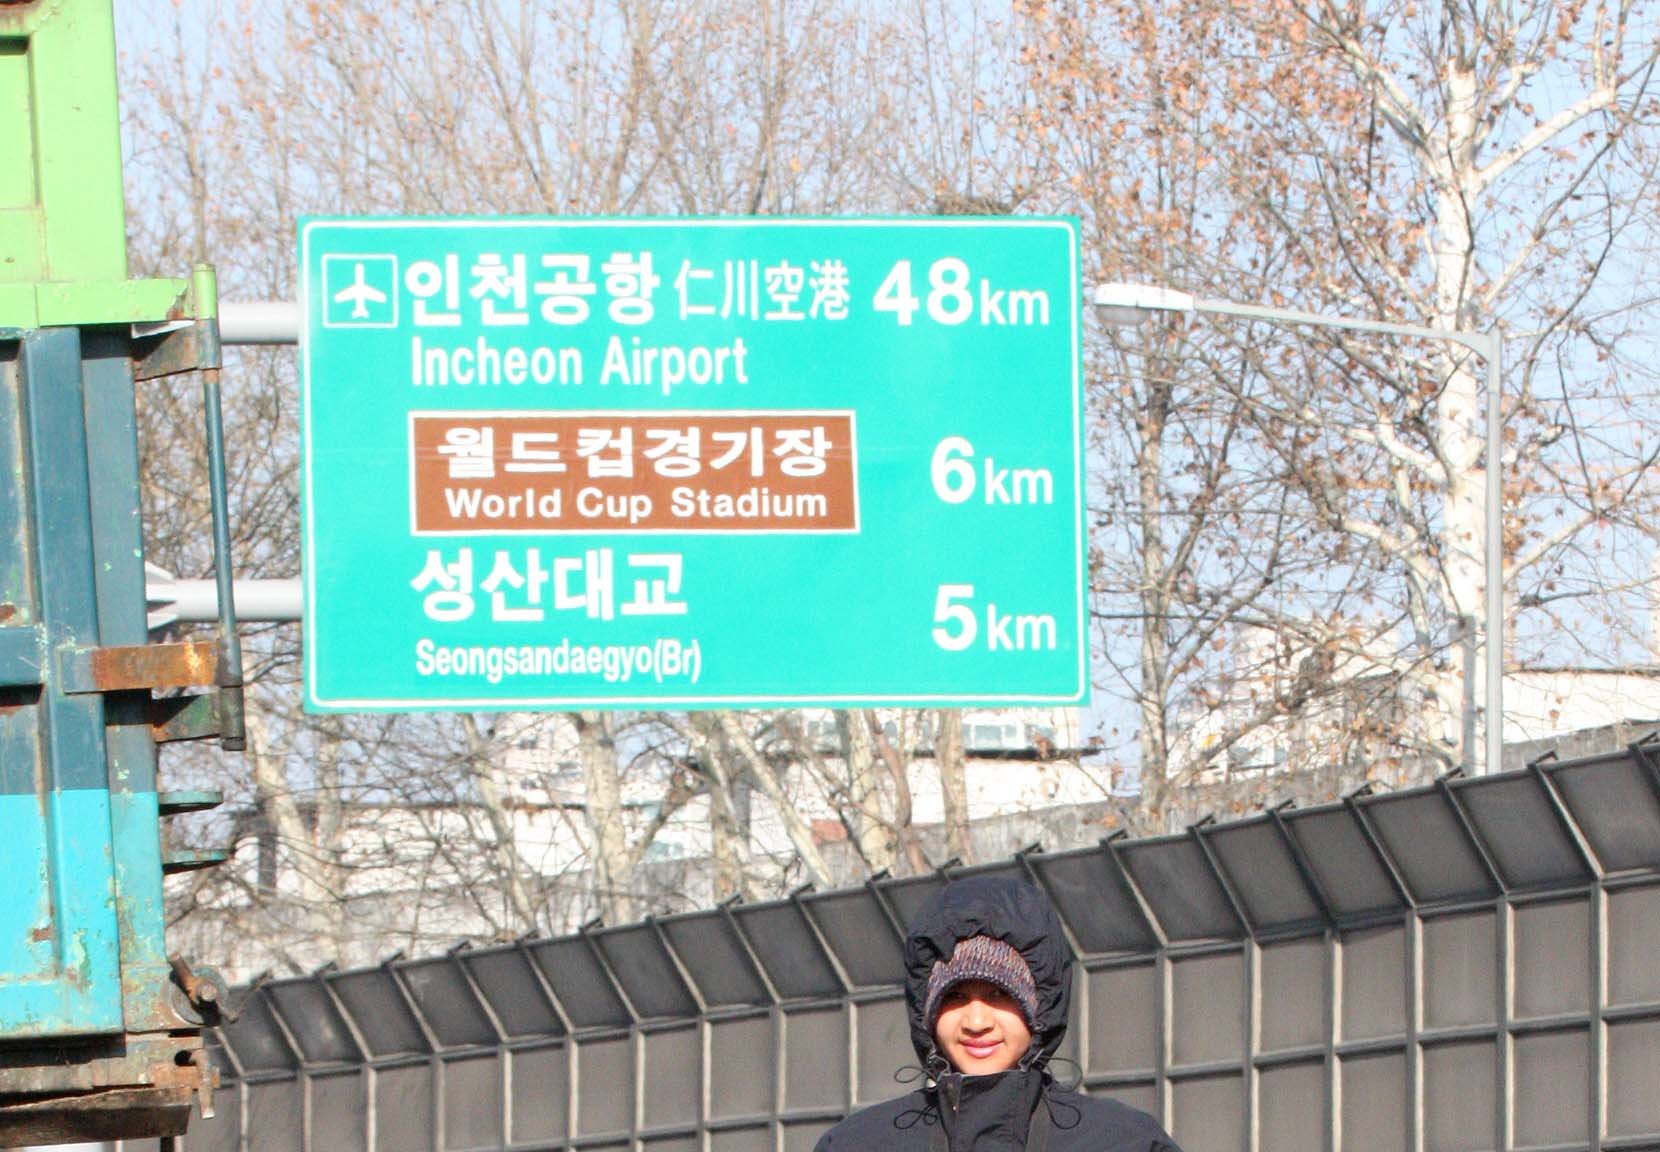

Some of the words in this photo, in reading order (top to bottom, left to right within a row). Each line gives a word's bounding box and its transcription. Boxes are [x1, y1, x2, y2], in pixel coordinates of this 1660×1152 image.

[404, 251, 661, 326] 인천공항
[673, 258, 851, 321] 仁川空港
[411, 335, 583, 387] Incheon
[600, 335, 749, 396] Airport
[437, 426, 833, 479] 월드컵경기장
[444, 487, 562, 518] World
[576, 487, 653, 524] Cup
[670, 486, 827, 518] Stadium
[409, 546, 689, 622] 성산대교
[415, 638, 702, 684] Seongsandaegyo(Br)
